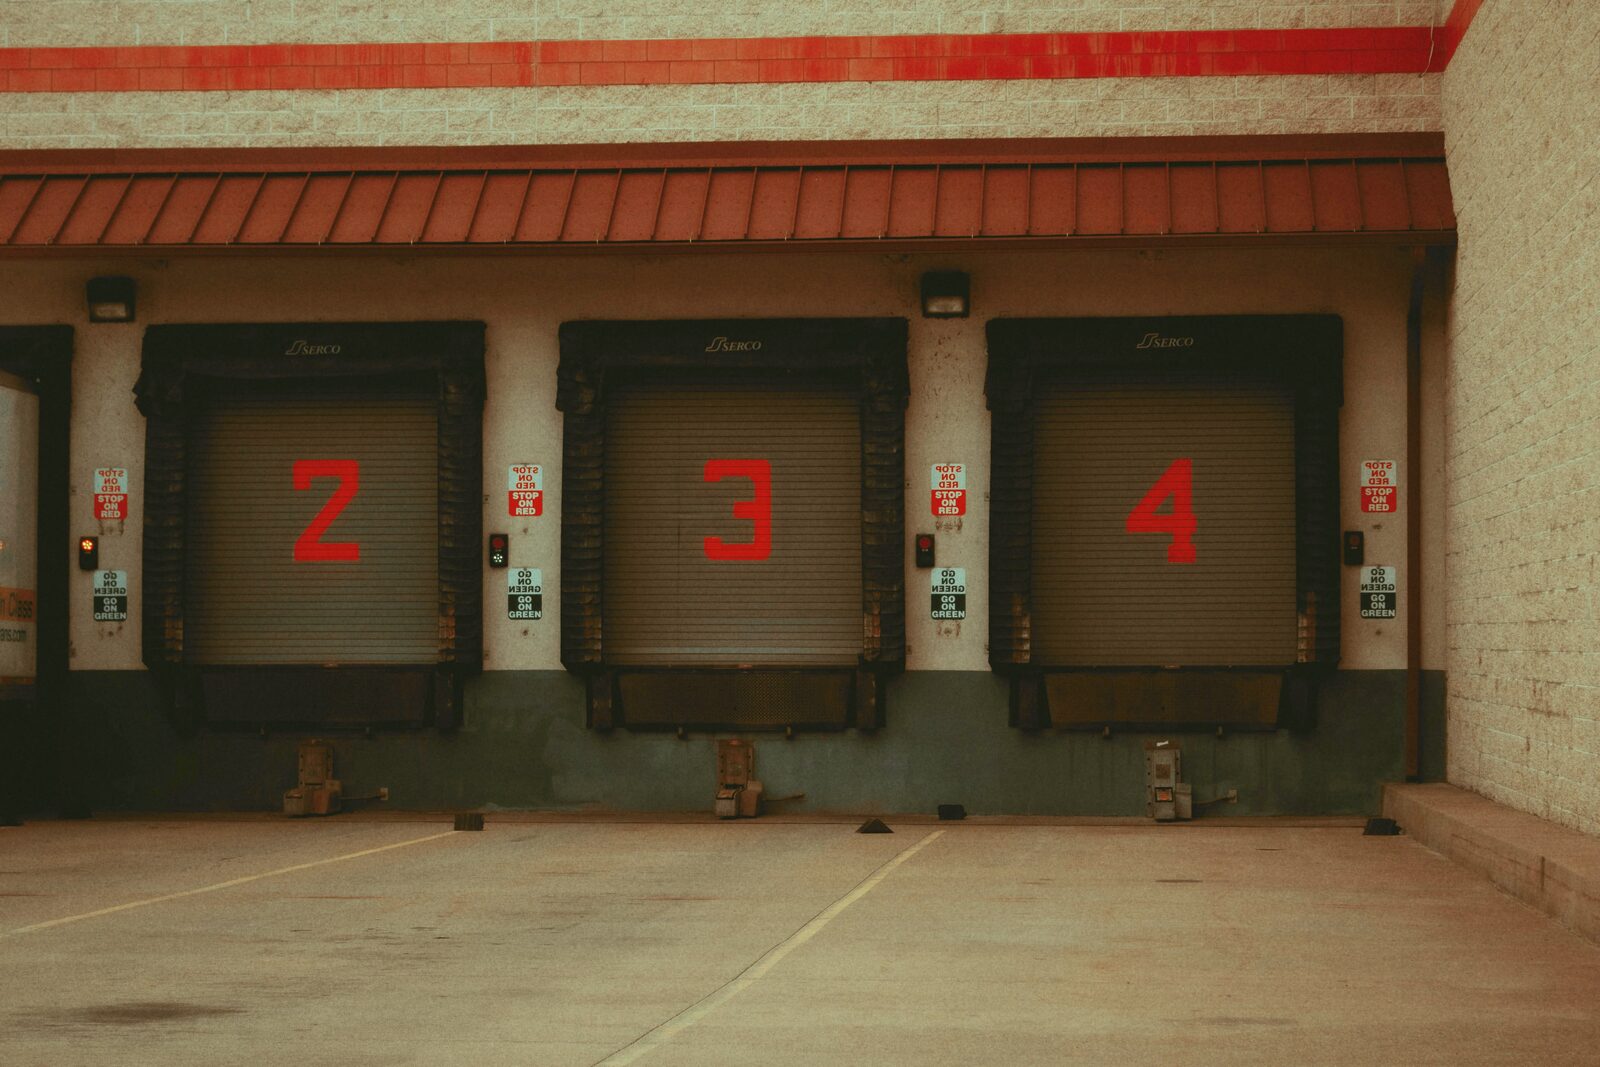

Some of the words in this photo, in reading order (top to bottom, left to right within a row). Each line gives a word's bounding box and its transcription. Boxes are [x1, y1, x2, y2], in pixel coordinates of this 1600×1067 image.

[722, 341, 762, 352] SERCO
[1153, 337, 1194, 348] SERCO
[302, 345, 341, 355] SERCO
[512, 492, 540, 500] STOP
[935, 491, 963, 499] STOP
[1364, 488, 1393, 496] STOP
[97, 495, 124, 503] STOP
[941, 499, 956, 507] ON
[293, 460, 359, 562] 2
[515, 507, 536, 515] RED
[704, 459, 771, 561] 3
[1126, 459, 1197, 564] 4
[517, 595, 532, 603] GO
[940, 595, 956, 603] GO
[1370, 594, 1386, 602] GO
[517, 603, 532, 611] ON
[941, 603, 956, 611] ON
[94, 612, 127, 620] GREEN
[508, 611, 542, 619] GREEN
[931, 610, 965, 618] GREEN
[1361, 609, 1395, 617] GREEN
